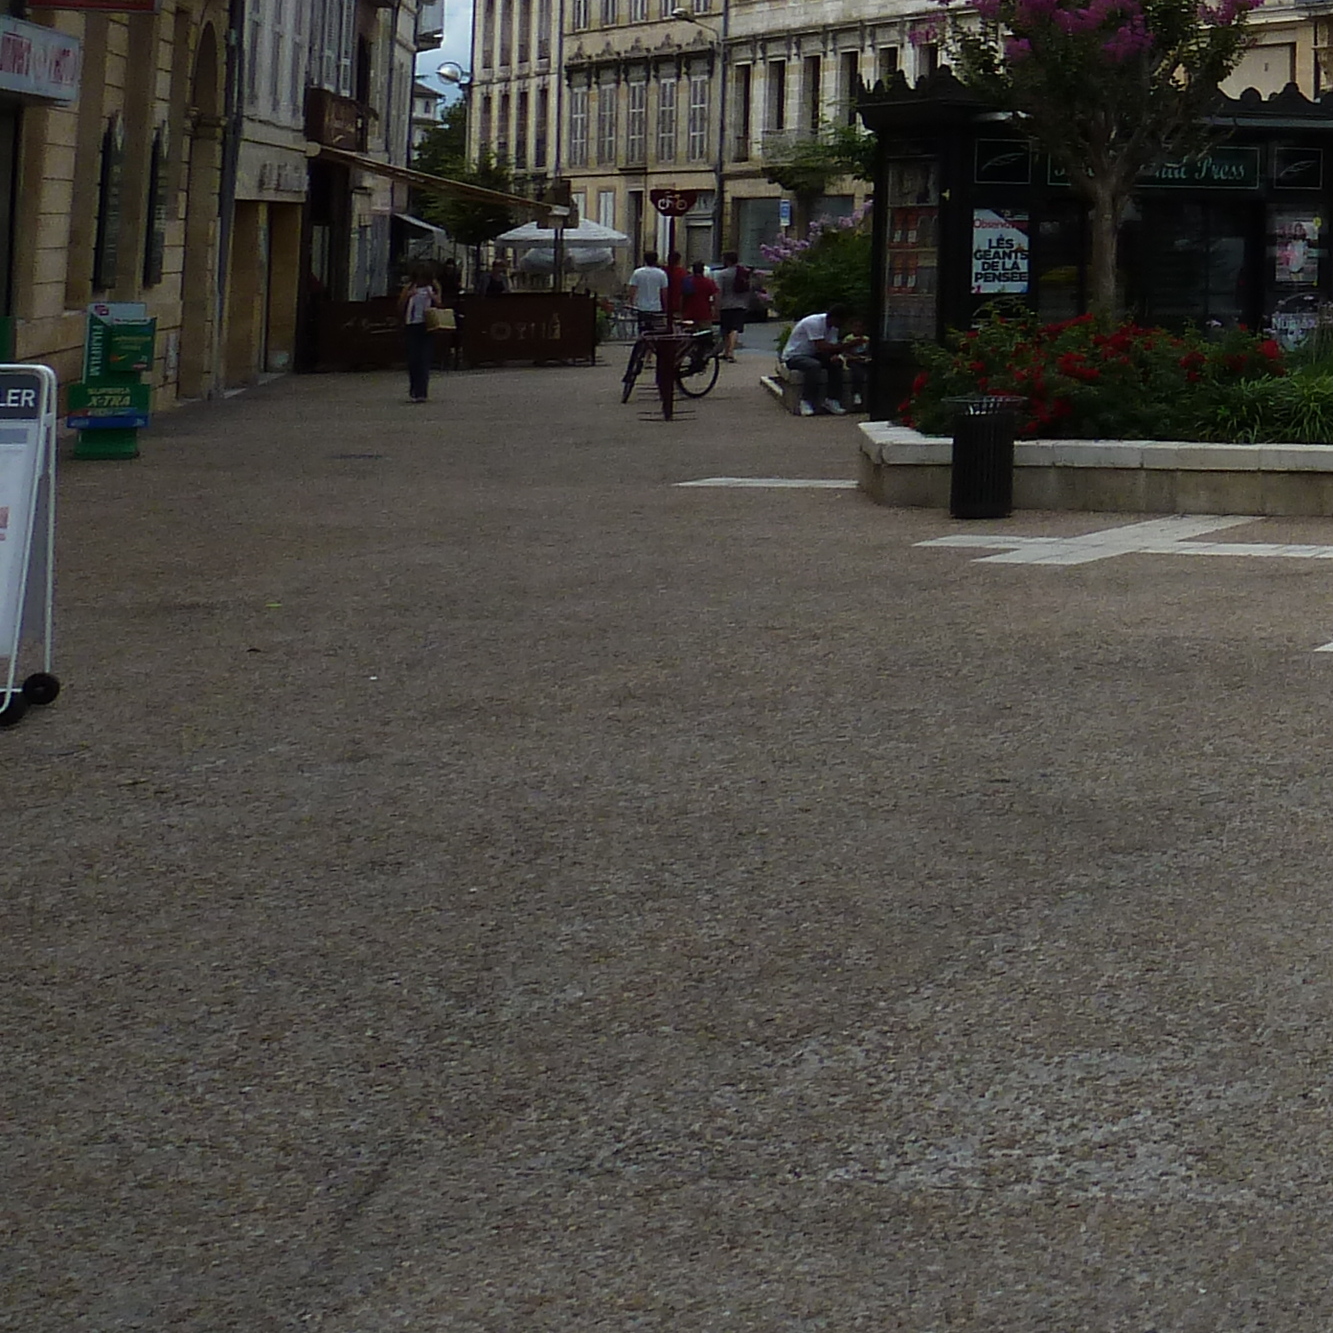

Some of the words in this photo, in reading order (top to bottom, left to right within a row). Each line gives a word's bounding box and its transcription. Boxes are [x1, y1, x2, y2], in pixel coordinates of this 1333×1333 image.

[1194, 154, 1246, 180] Press
[982, 261, 999, 271] DE
[1002, 261, 1020, 271] LA
[87, 395, 131, 407] X-TRA
